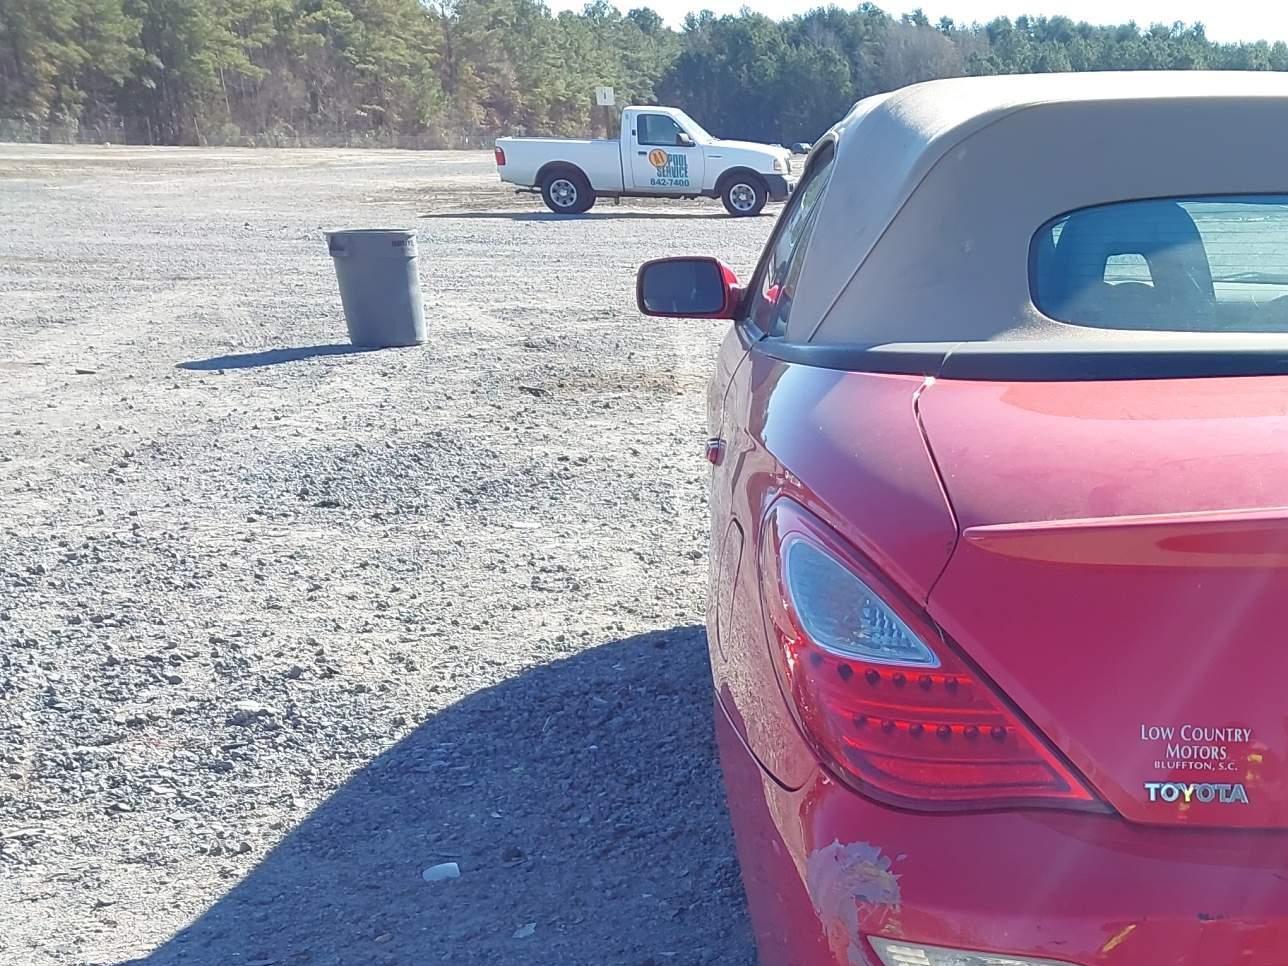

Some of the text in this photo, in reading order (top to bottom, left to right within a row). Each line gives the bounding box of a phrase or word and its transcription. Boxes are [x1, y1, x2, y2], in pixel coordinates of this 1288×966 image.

[667, 154, 687, 166] POOL
[656, 166, 689, 178] SERVICE
[650, 178, 690, 187] 842-7400
[1165, 743, 1227, 760] MOTORS
[1154, 761, 1238, 771] BLUFFTON, S.C.
[1144, 782, 1249, 804] TOYOTA
